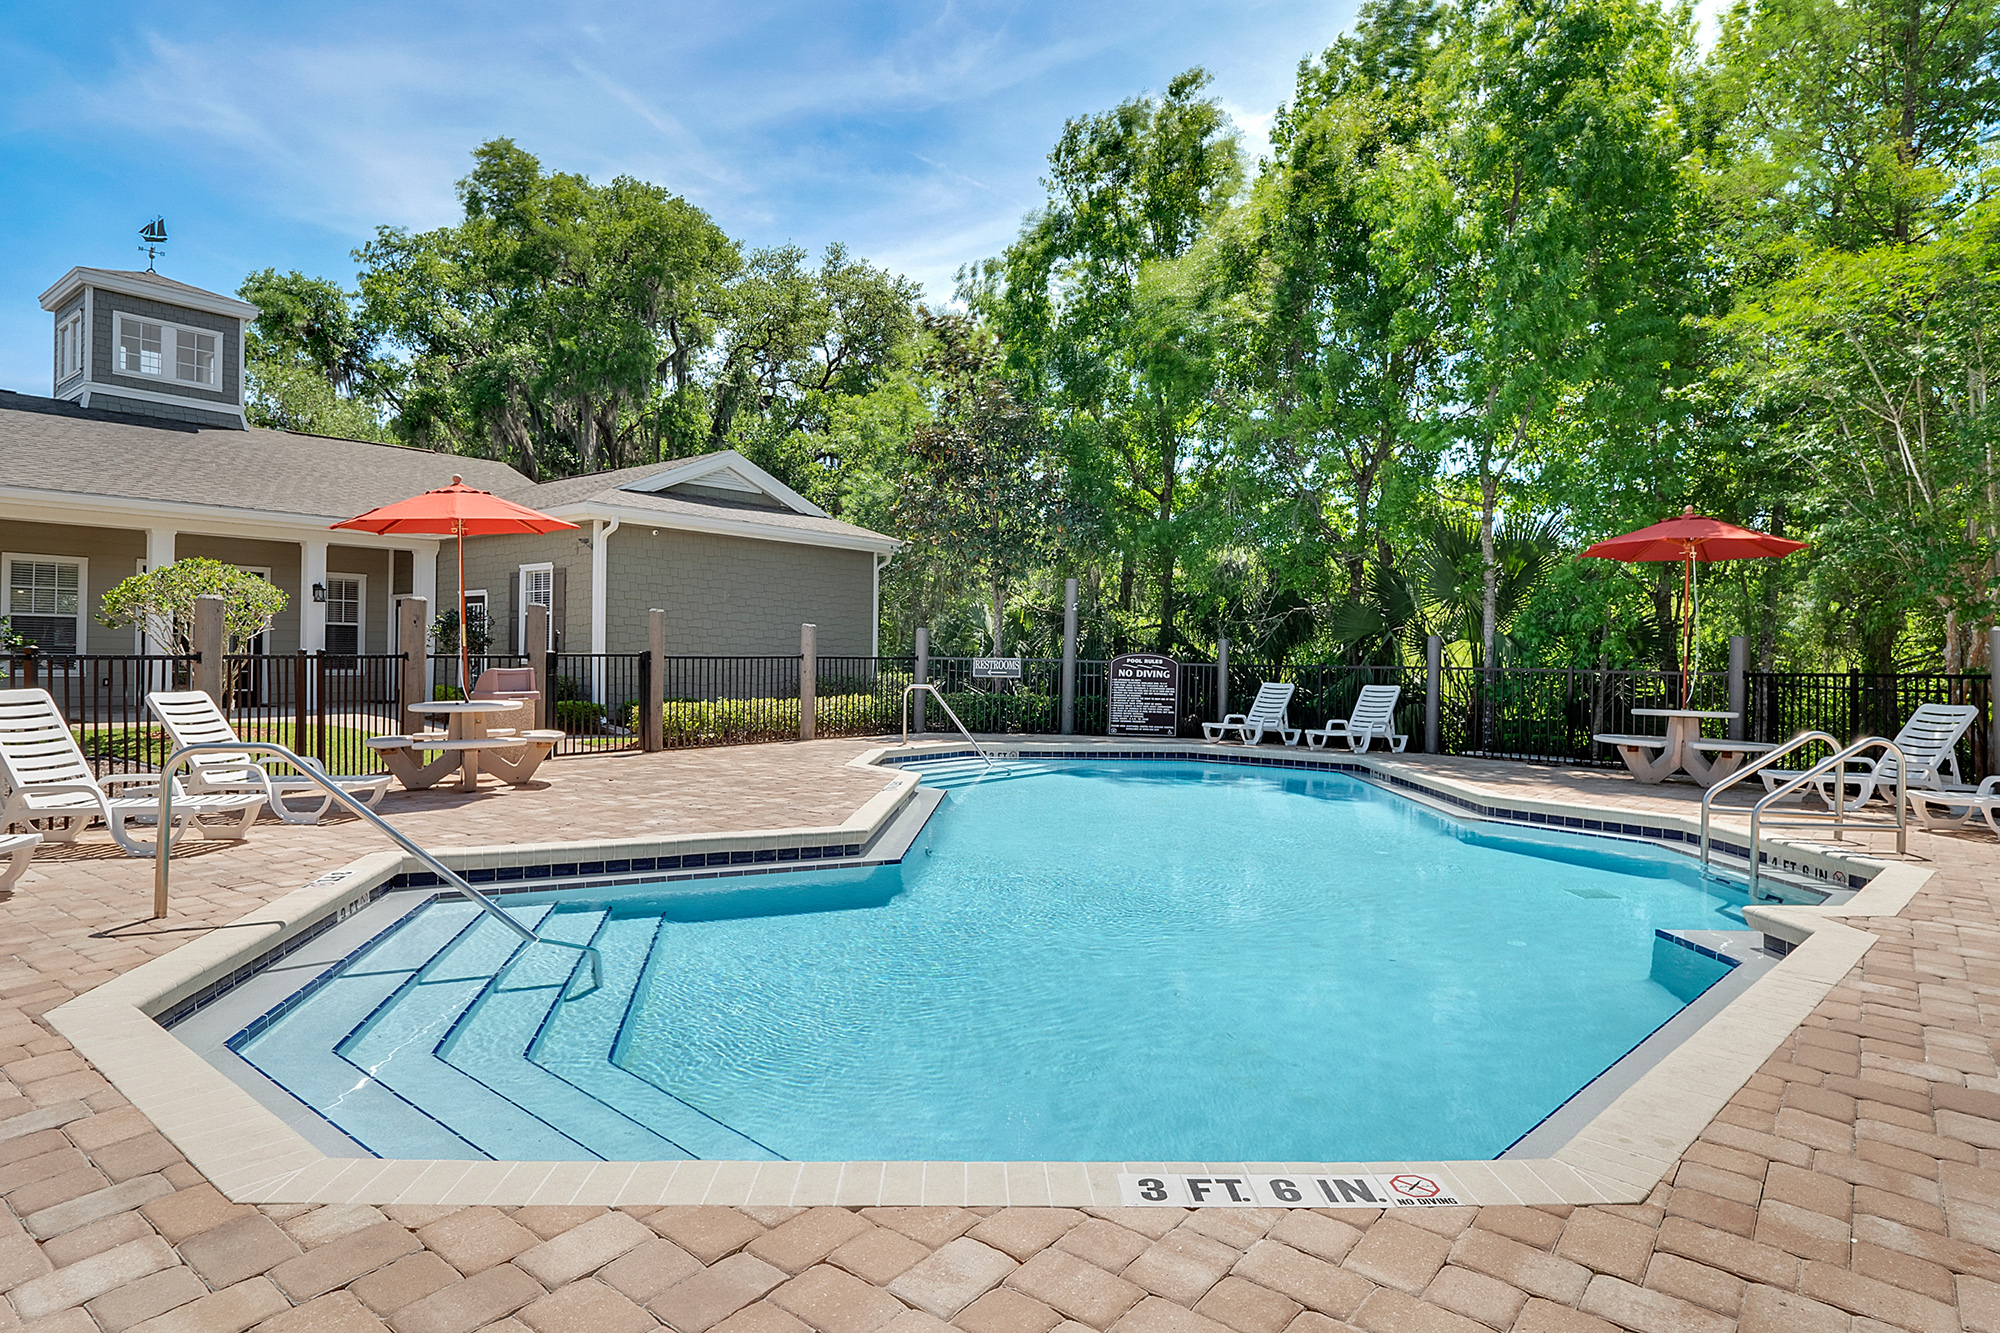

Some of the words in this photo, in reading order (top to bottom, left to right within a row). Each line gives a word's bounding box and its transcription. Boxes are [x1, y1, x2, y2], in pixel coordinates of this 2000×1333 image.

[975, 659, 1020, 670] RESTROOMS
[1118, 669, 1133, 677] NO
[1136, 669, 1170, 679] DIVING
[1138, 1178, 1168, 1202] 3
[1186, 1178, 1251, 1203] FT.
[1269, 1178, 1303, 1203] 6
[1316, 1178, 1388, 1204] IN.
[1416, 1197, 1459, 1205] DIVING
